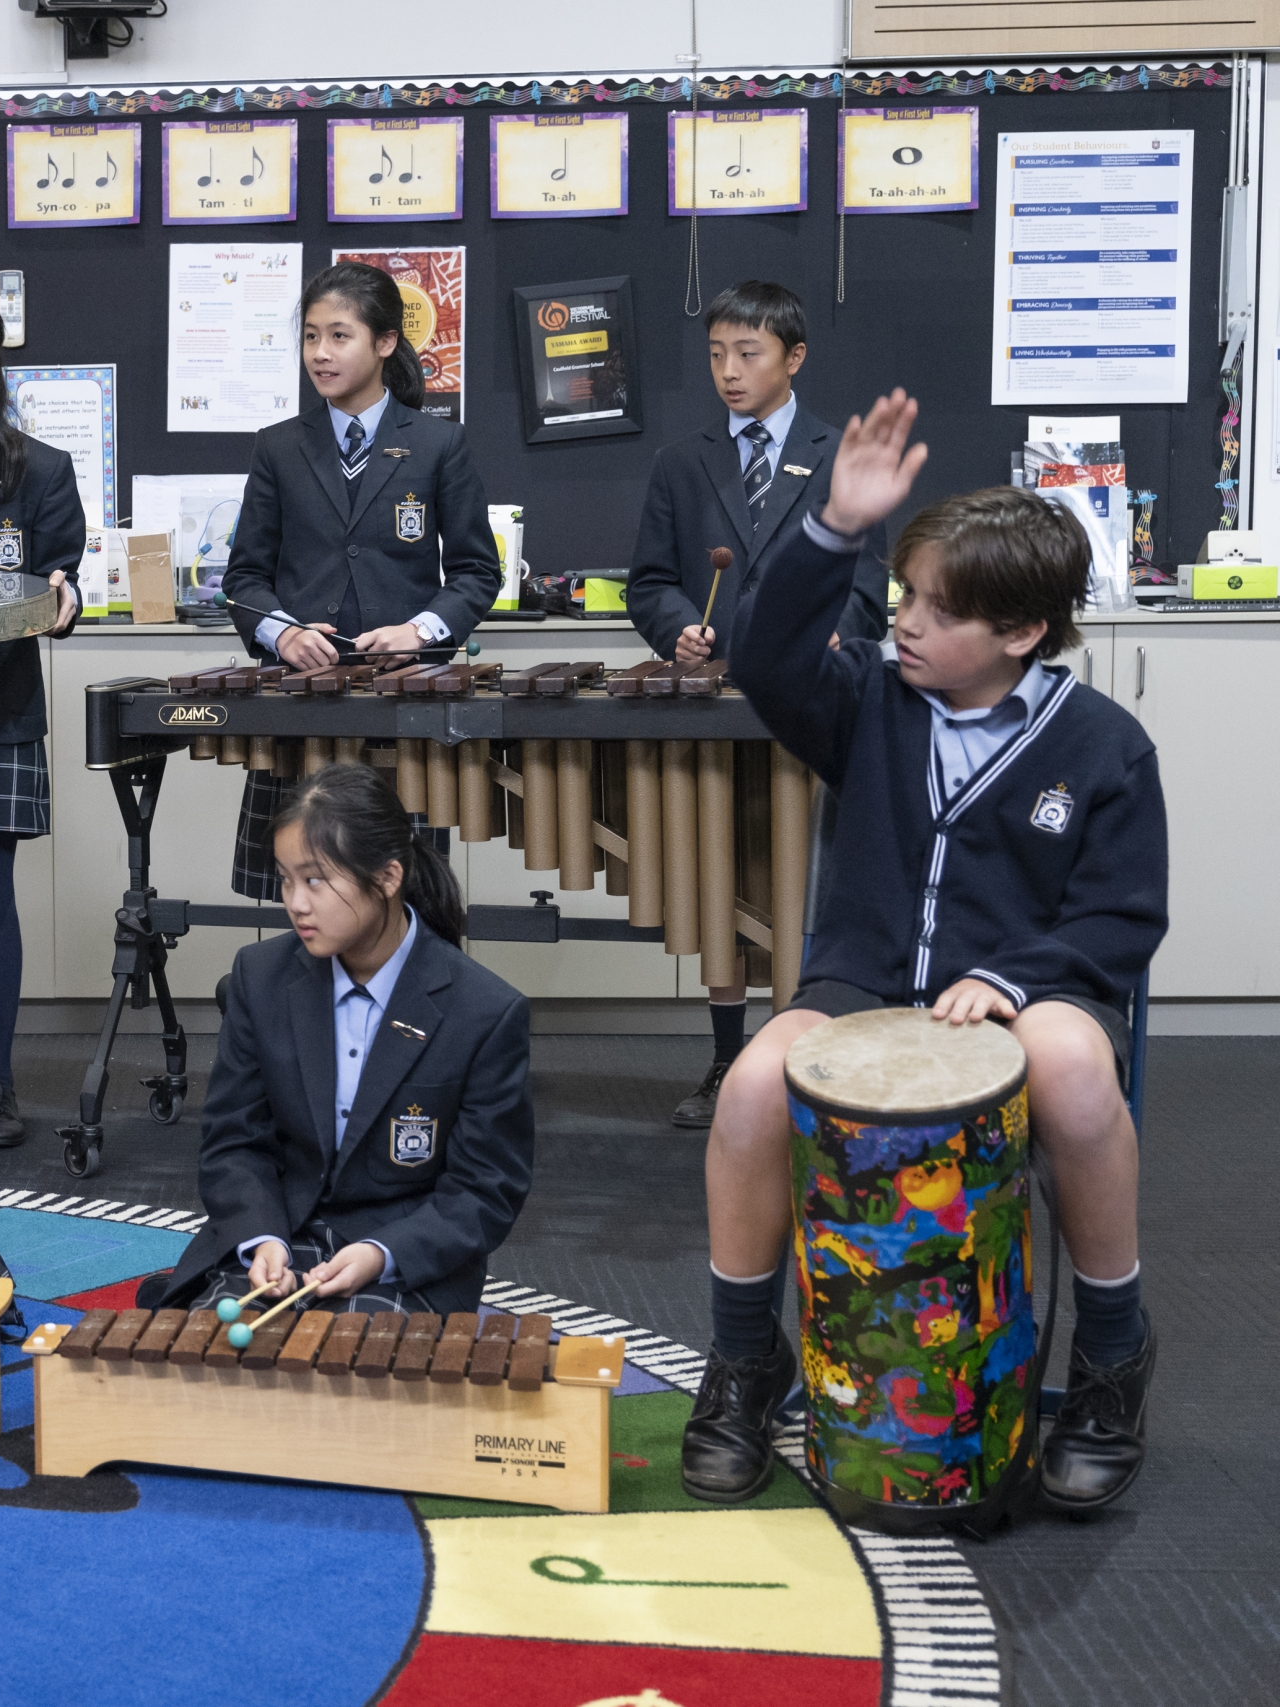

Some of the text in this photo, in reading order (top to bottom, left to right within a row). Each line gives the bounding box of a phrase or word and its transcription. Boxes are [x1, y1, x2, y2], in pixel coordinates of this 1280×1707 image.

[717, 111, 759, 123] Sing First Sight
[887, 109, 930, 121] Sing First Sight
[375, 119, 416, 131] Sing First Sight
[538, 115, 580, 127] Sing First Sight
[82, 126, 94, 136] Sight
[238, 122, 250, 133] Sight
[1011, 141, 1131, 151] Our Student Behaviours.
[542, 192, 576, 202] Ta-ah
[709, 188, 765, 199] Ta-ah-ah
[869, 186, 946, 198] Ta-ah-ah-ah
[198, 198, 253, 209] Tam ti
[370, 197, 421, 206] Ti tam
[96, 202, 111, 213] pa
[403, 312, 415, 320] OR
[570, 311, 611, 323] FESTIVAL
[551, 340, 577, 348] YAMAHA
[85, 399, 97, 407] help
[169, 707, 218, 723] ADAMS
[475, 1435, 566, 1454] PRIMARY LINE
[510, 1458, 536, 1466] SONOR
